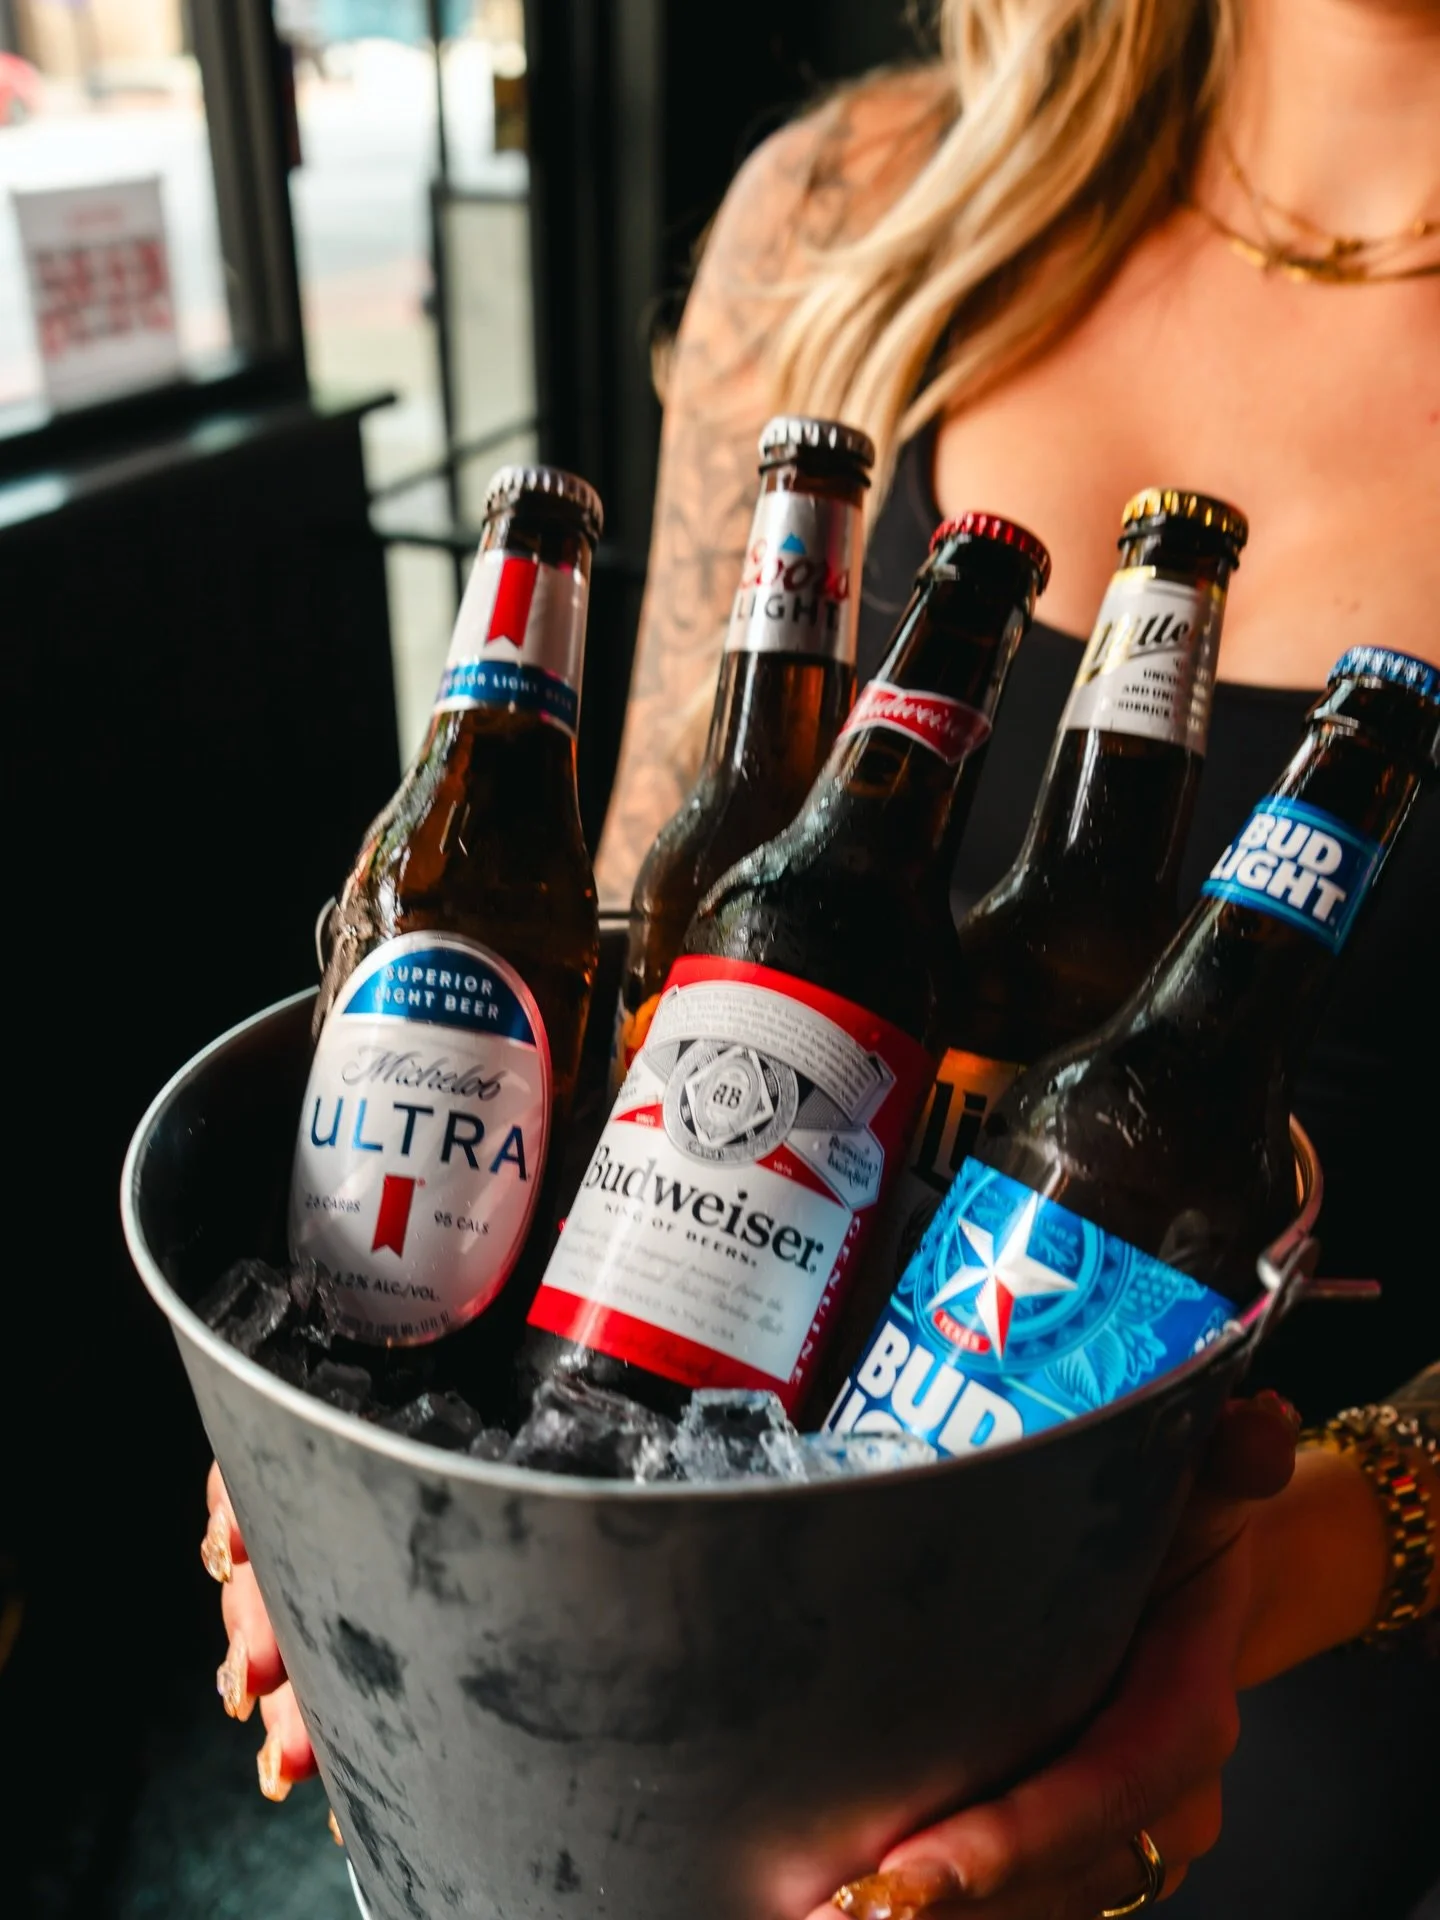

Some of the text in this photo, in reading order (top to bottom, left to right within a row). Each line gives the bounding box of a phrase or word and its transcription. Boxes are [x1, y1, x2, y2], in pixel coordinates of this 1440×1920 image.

[1083, 610, 1191, 684] Mille
[1240, 812, 1343, 876] BUD
[1209, 844, 1347, 922] LIGHT
[385, 964, 493, 997] SUPERIOR
[444, 993, 499, 1020] BEER
[342, 1045, 507, 1101] Michelob
[310, 1095, 529, 1181] ULTRA
[579, 1145, 825, 1273] Budweiser
[652, 1217, 676, 1232] OF
[857, 1320, 1025, 1458] BUD
